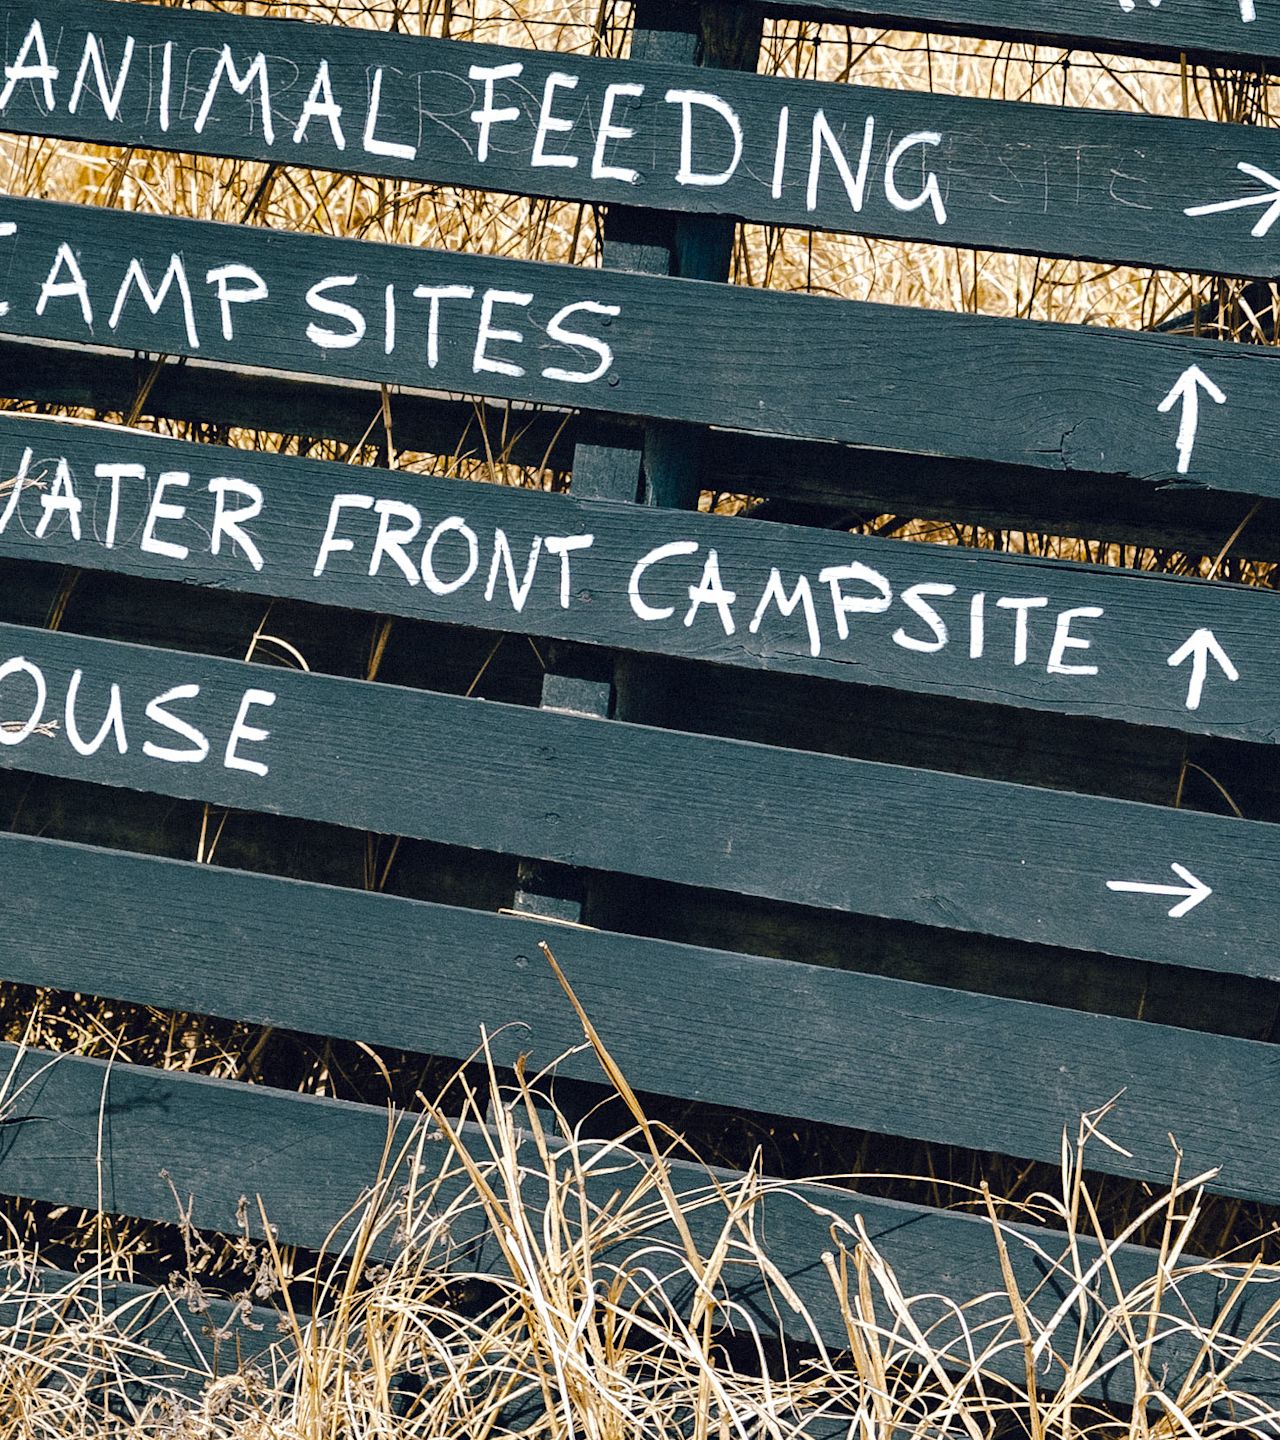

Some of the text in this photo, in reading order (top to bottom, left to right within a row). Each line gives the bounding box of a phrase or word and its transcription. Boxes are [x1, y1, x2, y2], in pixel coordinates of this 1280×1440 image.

[467, 61, 949, 226] FEEDING
[312, 492, 596, 615] FRONT
[626, 539, 1105, 677] CAMPSITE
